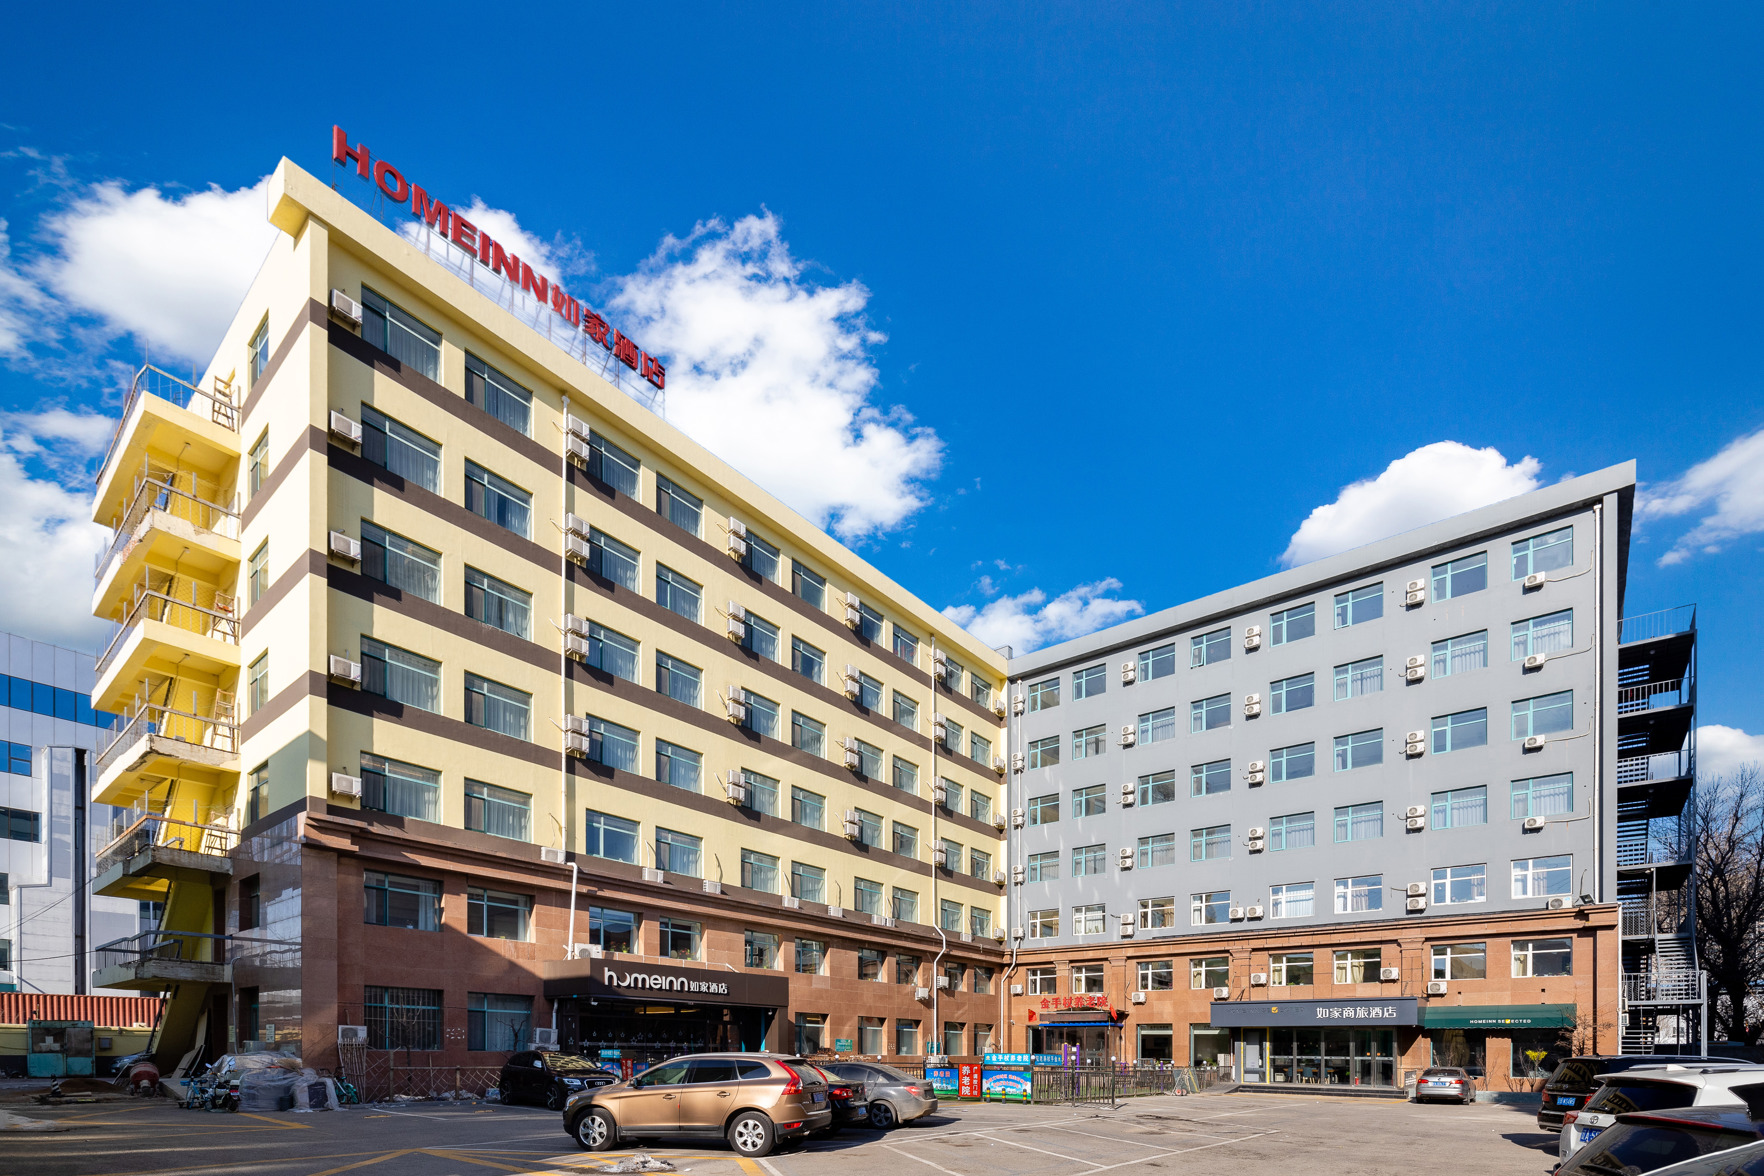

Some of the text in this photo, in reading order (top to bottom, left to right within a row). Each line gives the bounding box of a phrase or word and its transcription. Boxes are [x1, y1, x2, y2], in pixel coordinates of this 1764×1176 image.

[332, 124, 666, 391] HOMEINN 如家酒店
[689, 980, 729, 995] 如家酒店
[1039, 995, 1109, 1010] 金手杖养老院
[1315, 1006, 1397, 1019] 如家商旅酒店
[961, 1065, 971, 1096] 养老院
